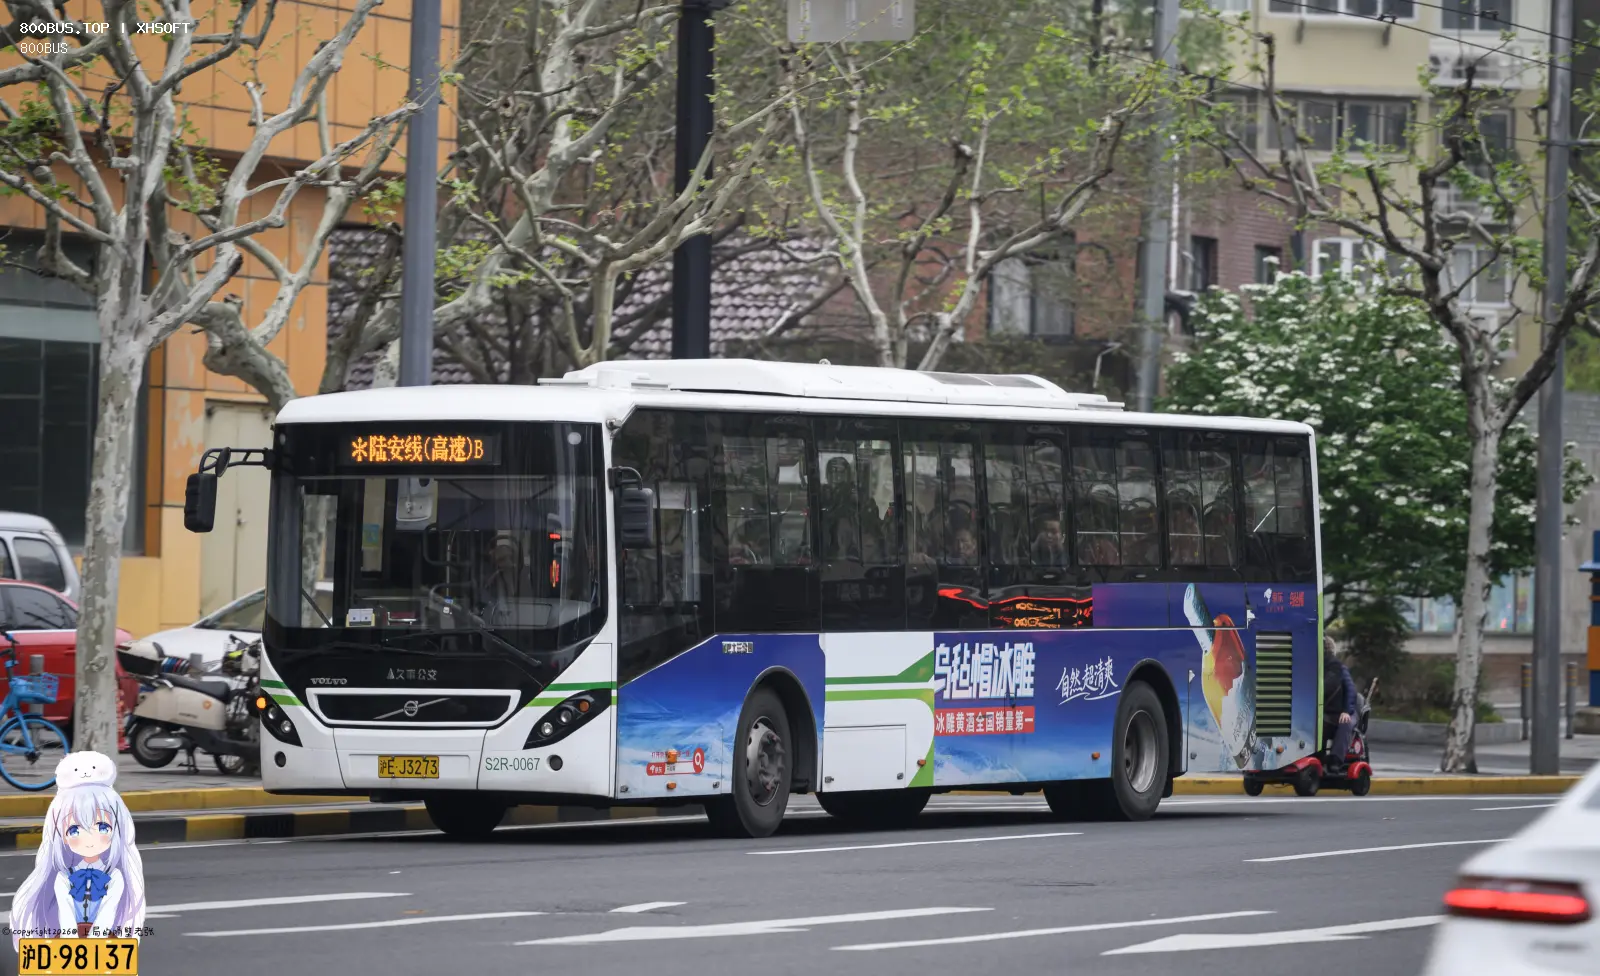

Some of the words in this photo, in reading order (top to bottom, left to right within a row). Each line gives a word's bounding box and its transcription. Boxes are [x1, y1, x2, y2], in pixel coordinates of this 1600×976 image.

[933, 642, 1036, 700] 乌毡帽冰雕
[310, 677, 348, 685] VOLVO
[935, 710, 1034, 735] 冰雕黄酒全国销量第一
[485, 757, 541, 771] S2R-0067
